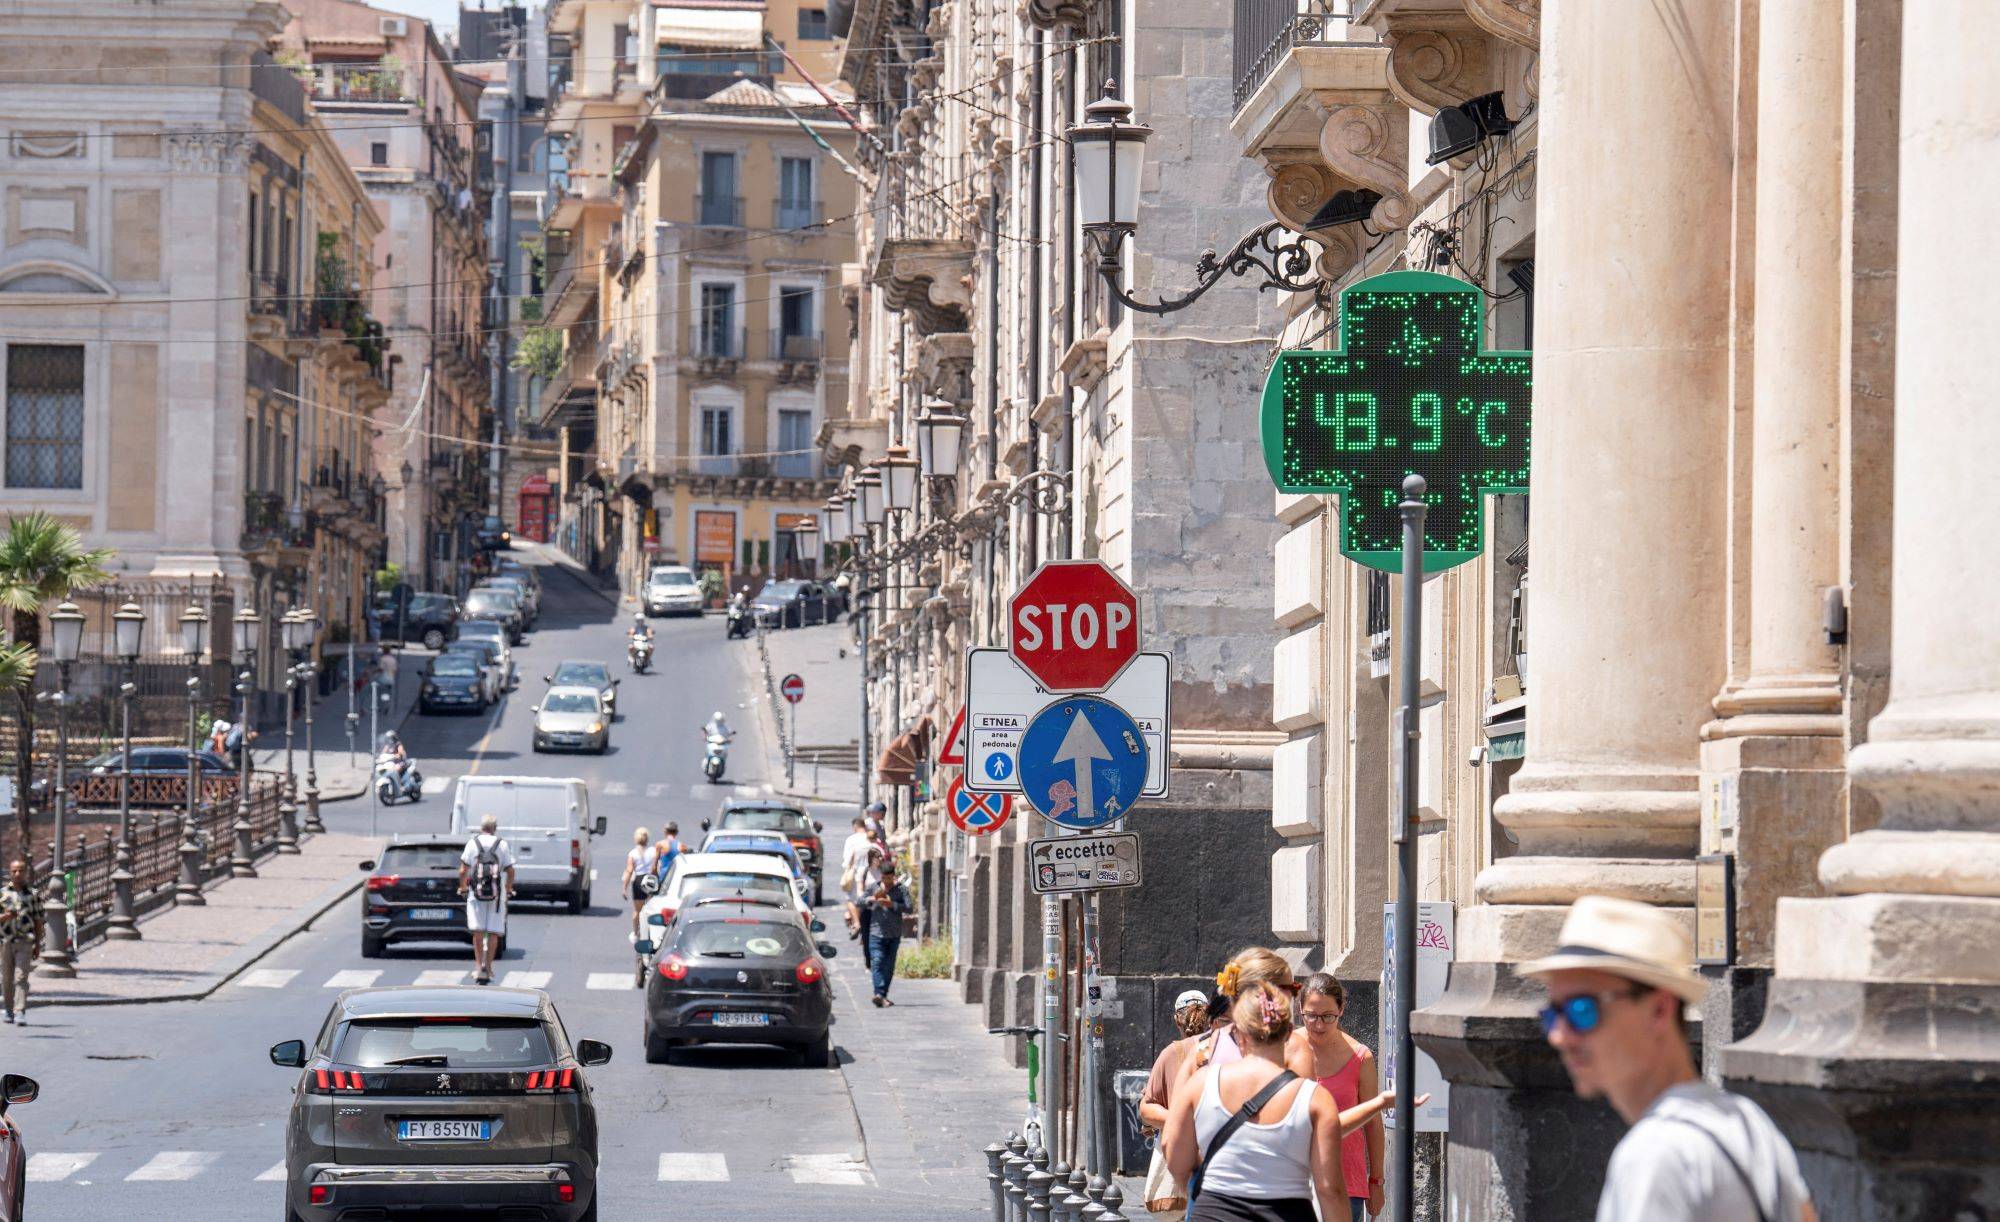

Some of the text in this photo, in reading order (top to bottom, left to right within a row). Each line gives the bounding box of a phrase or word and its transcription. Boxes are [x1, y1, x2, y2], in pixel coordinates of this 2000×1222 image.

[1315, 393, 1506, 450] 43.9 °C
[1018, 603, 1131, 651] STOP
[982, 718, 1018, 726] ETNEA
[1056, 841, 1115, 859] eccetto
[410, 1122, 479, 1137] FY 855YN
